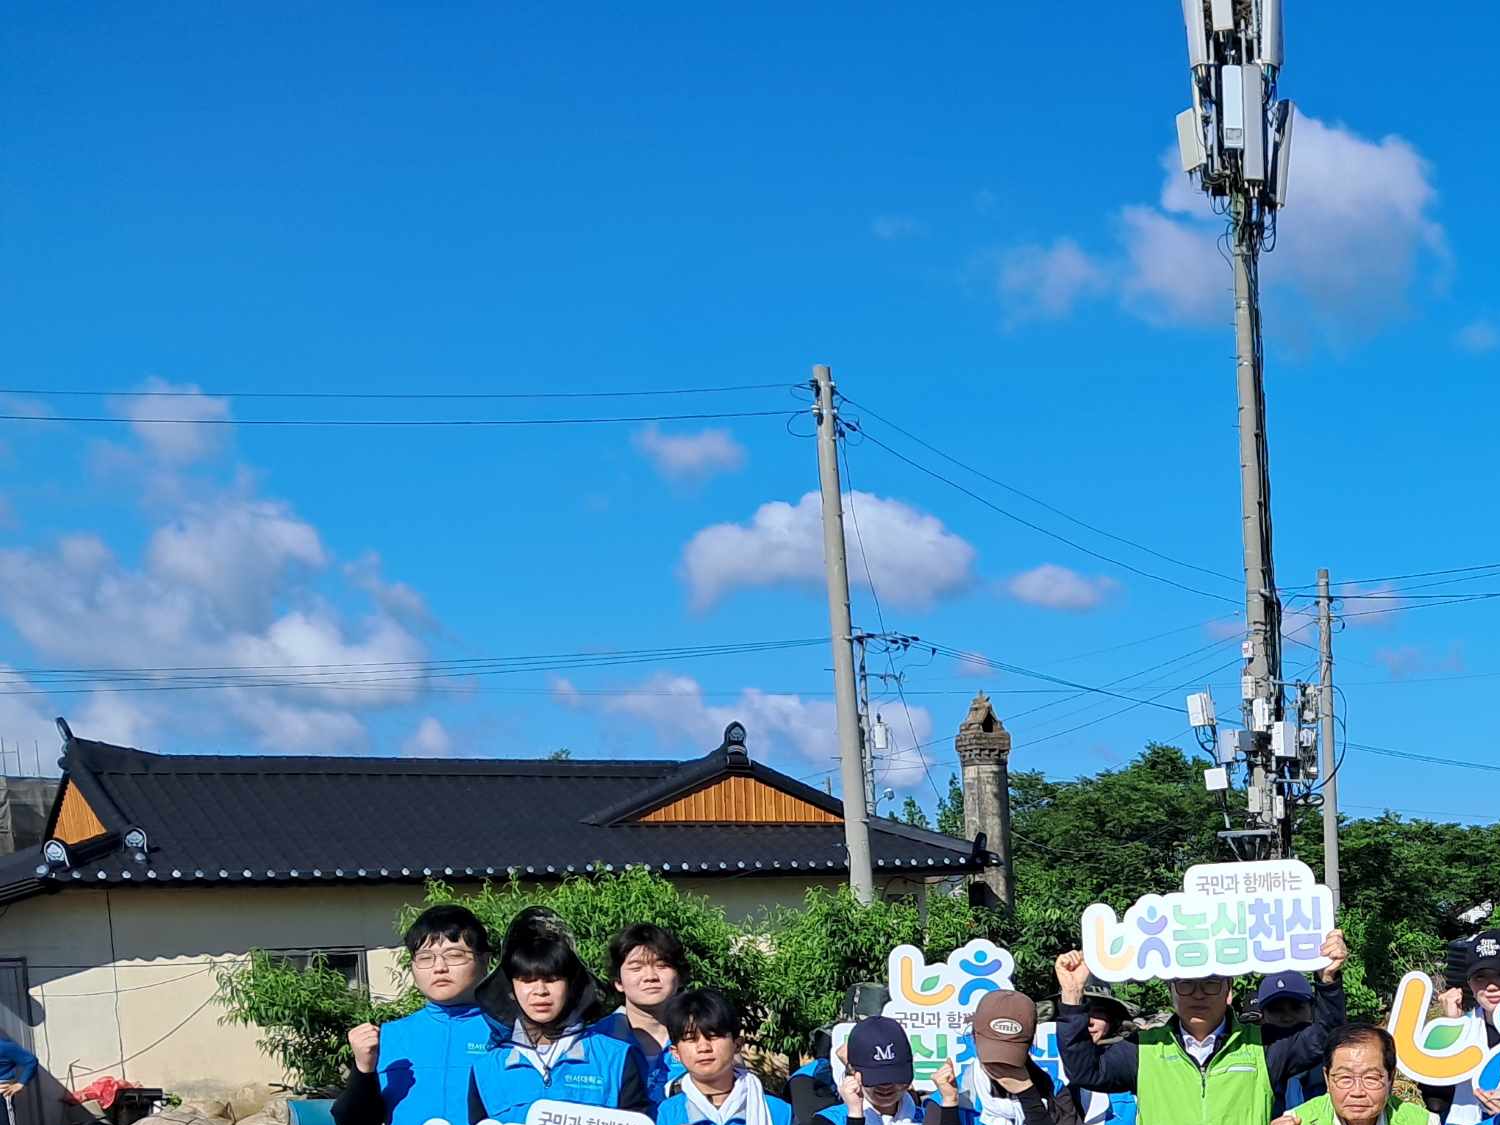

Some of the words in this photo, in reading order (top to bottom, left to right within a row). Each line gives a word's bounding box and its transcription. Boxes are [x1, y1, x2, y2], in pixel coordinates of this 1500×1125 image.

[1196, 874, 1240, 895] 국민과
[1243, 871, 1302, 893] 함께하는
[1172, 896, 1322, 967] 농심천심
[895, 1011, 941, 1030] 국민과
